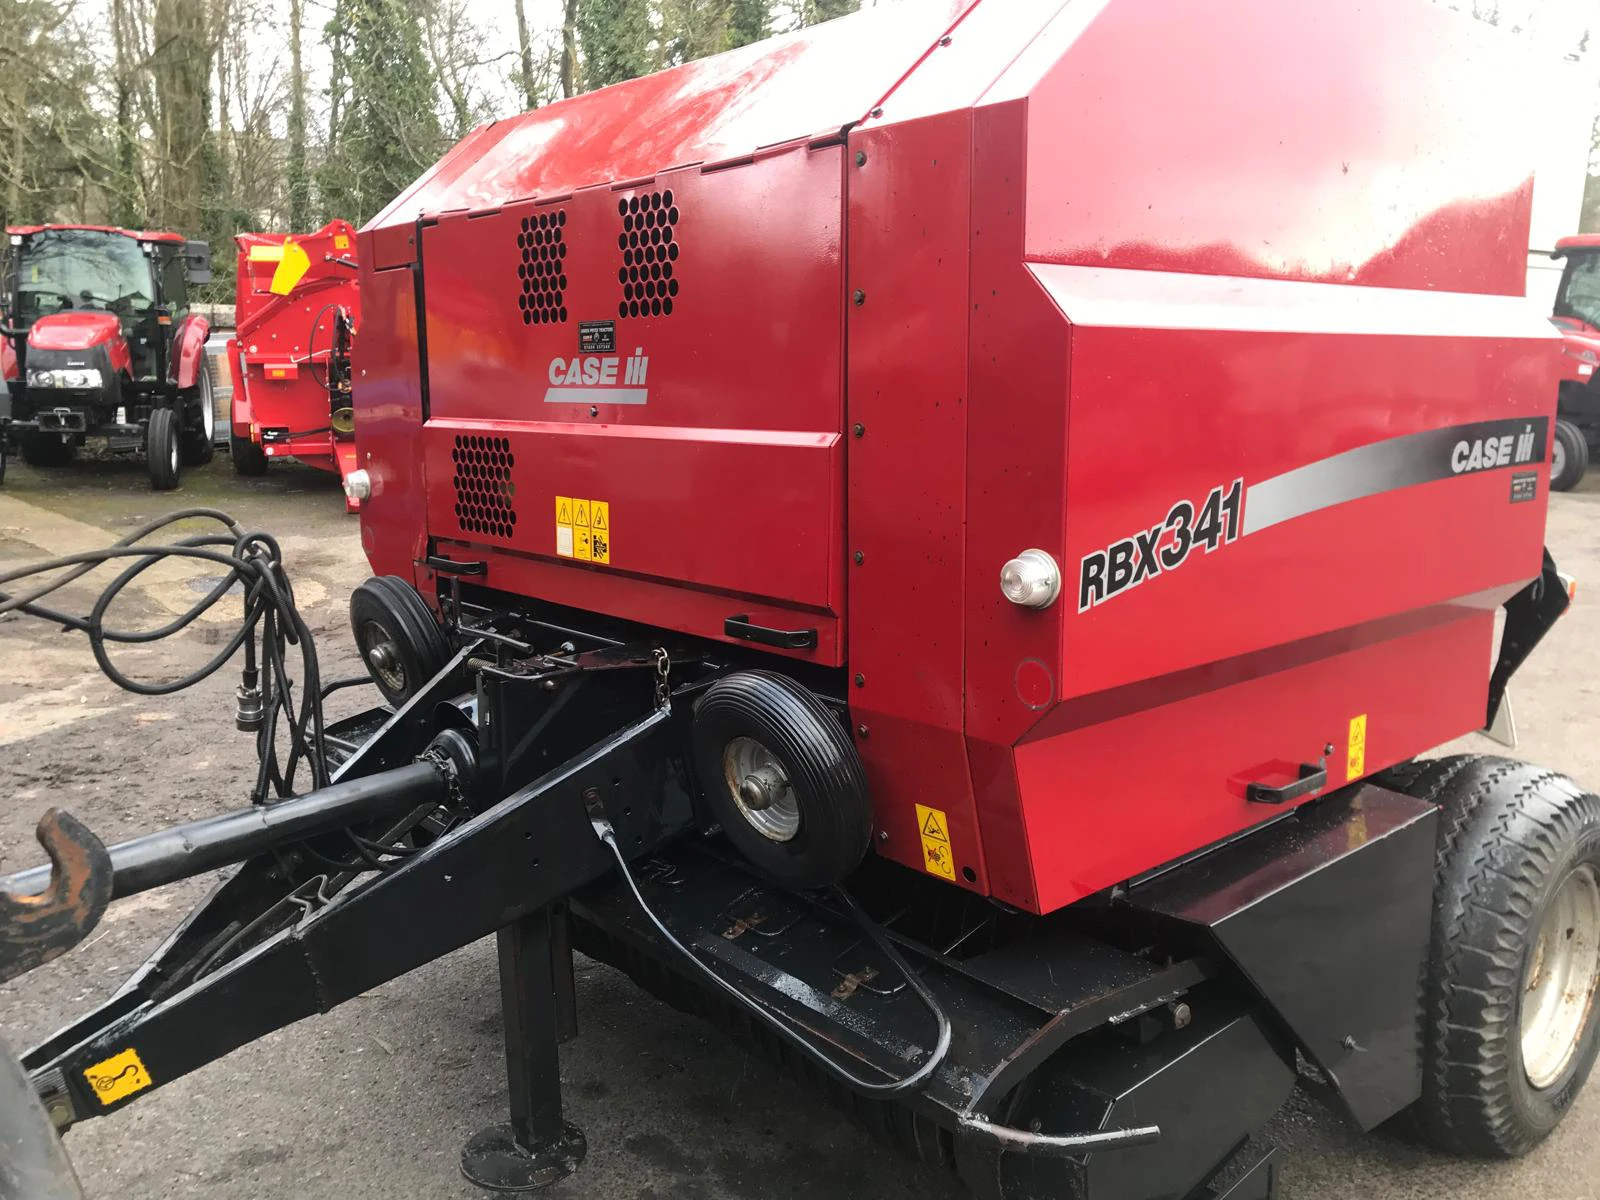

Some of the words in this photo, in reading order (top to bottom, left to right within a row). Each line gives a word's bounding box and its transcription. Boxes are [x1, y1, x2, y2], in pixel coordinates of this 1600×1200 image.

[548, 356, 619, 386] CASE
[1451, 435, 1514, 473] CASE
[1079, 478, 1243, 612] RBX341
